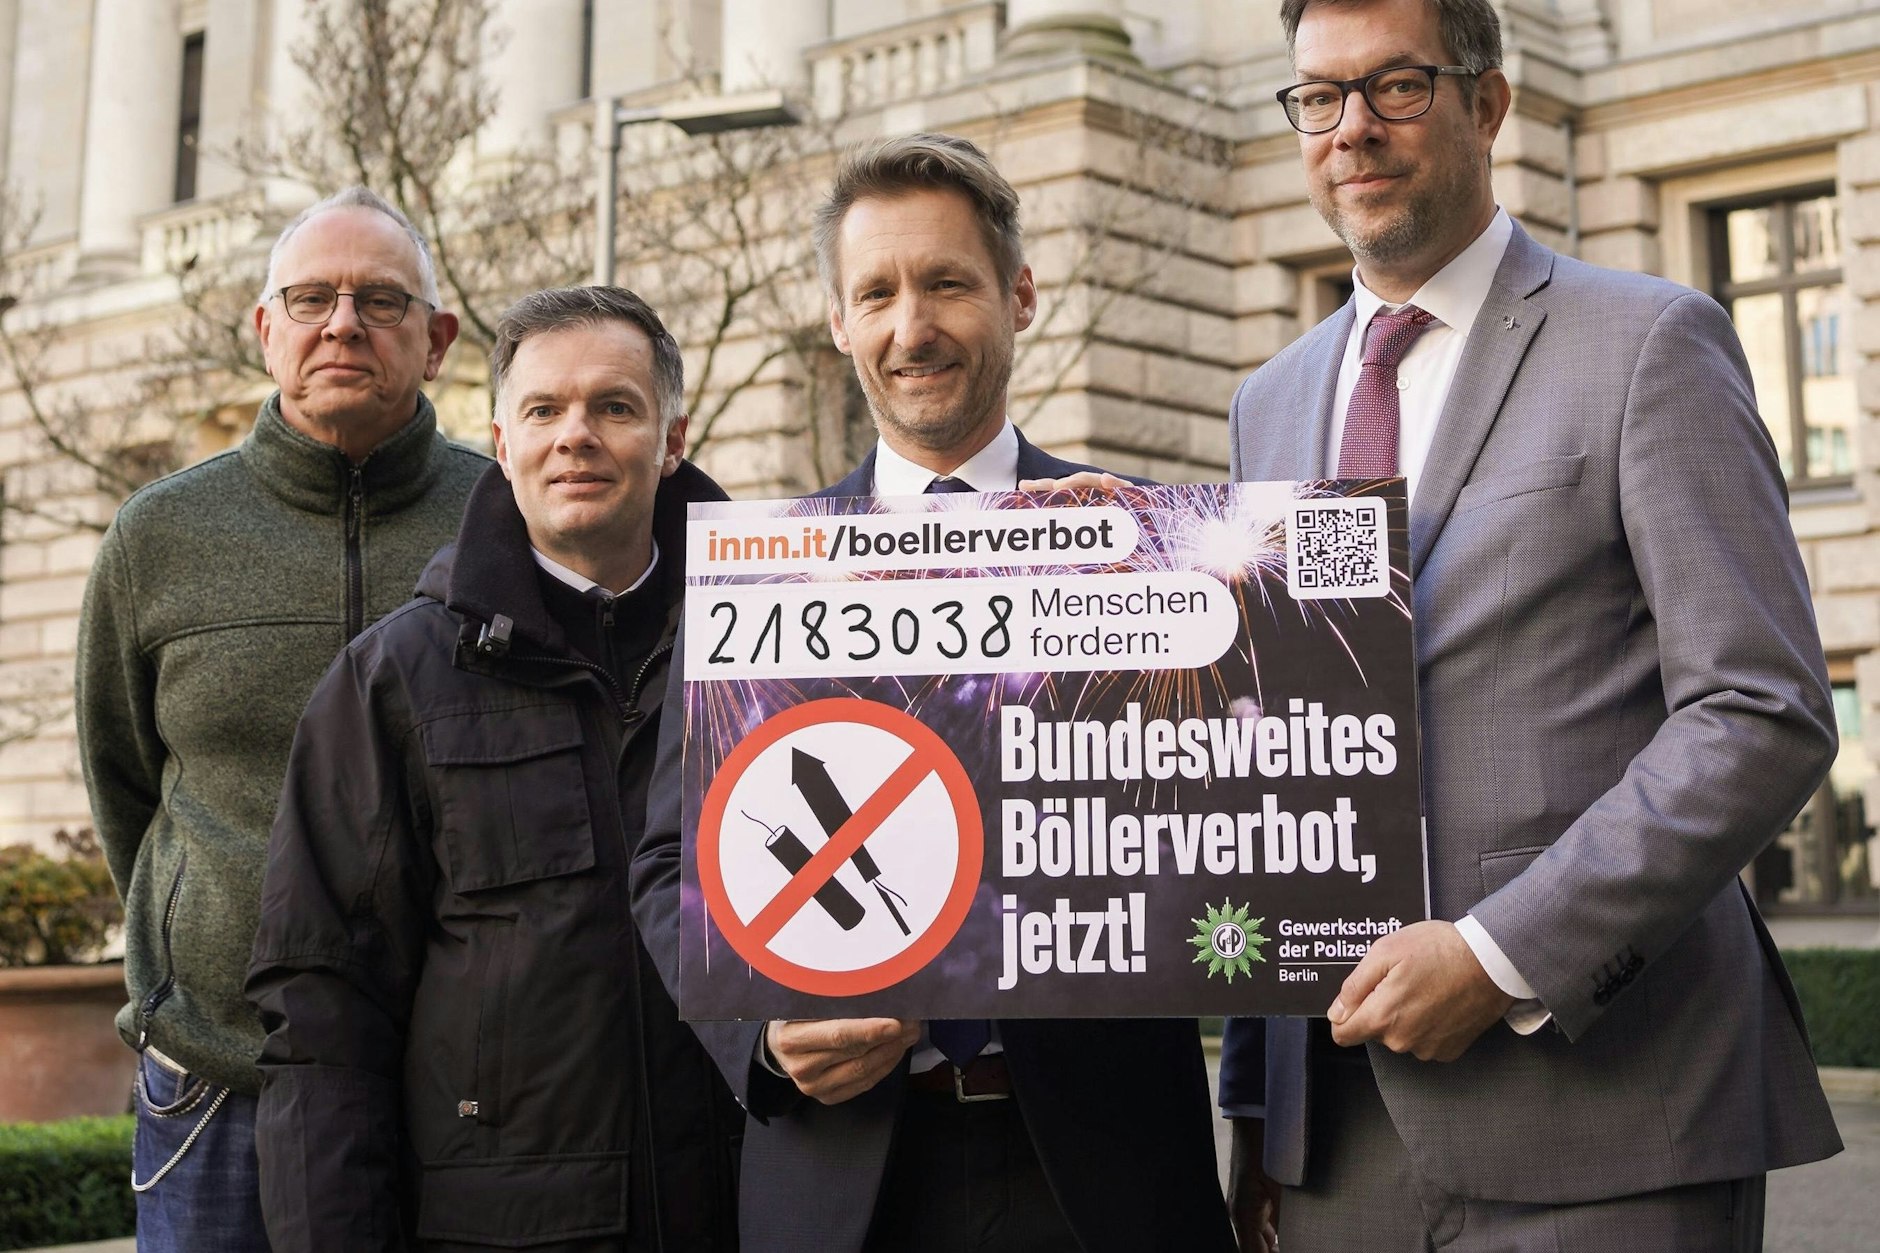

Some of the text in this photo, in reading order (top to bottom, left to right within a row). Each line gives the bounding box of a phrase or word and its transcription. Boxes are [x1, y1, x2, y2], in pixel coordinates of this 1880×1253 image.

[708, 518, 1113, 562] innn.it/boellerverbot
[1031, 585, 1208, 617] Menschen
[708, 595, 1013, 664] 2183038
[1030, 626, 1170, 657] fordern:
[1001, 698, 1398, 782] Bundesweites
[1002, 794, 1377, 883] Böllerverbot,
[998, 892, 1147, 990] jetzt!
[1278, 941, 1309, 958] der
[1278, 968, 1319, 982] Berlin
